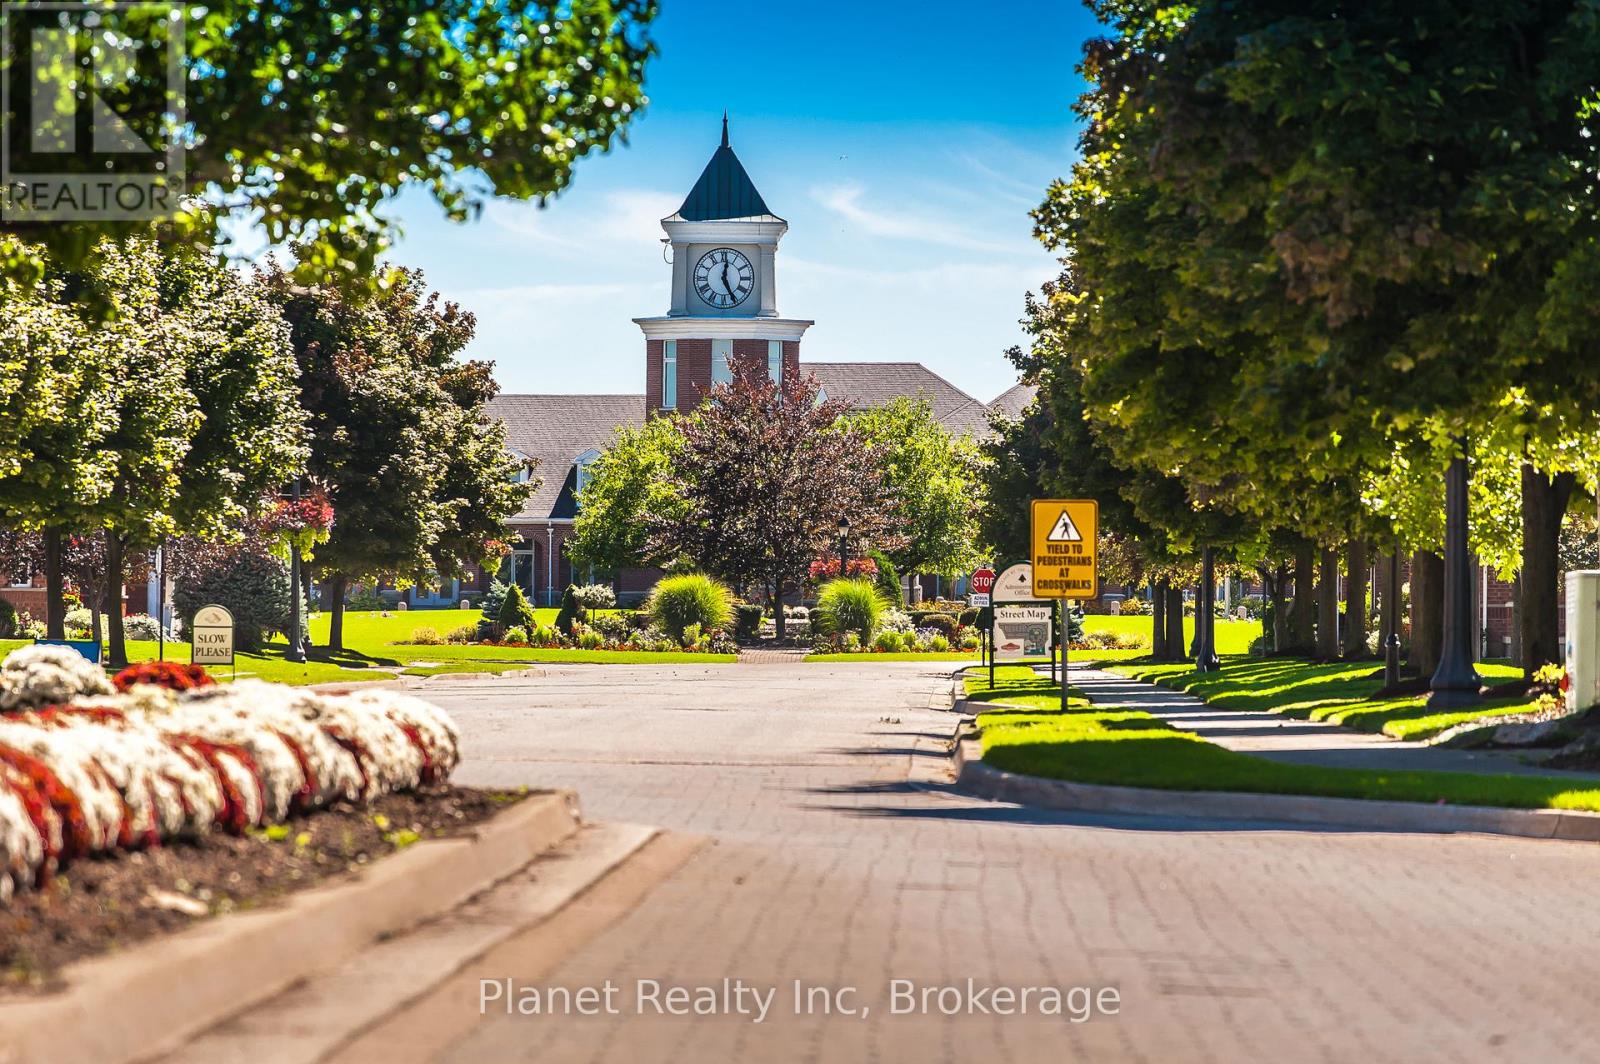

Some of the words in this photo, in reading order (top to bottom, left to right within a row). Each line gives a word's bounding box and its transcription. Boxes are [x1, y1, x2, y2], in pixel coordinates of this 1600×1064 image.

[1047, 544, 1070, 554] YIELD
[1072, 544, 1083, 554] TO
[1037, 556, 1092, 566] PEDESTRIANS
[1059, 567, 1070, 578] AT
[1037, 579, 1092, 589] CROSSWALKS
[1000, 610, 1025, 618] Street
[1027, 610, 1046, 620] Map
[198, 633, 227, 644] SLOW
[195, 647, 231, 656] PLEASE
